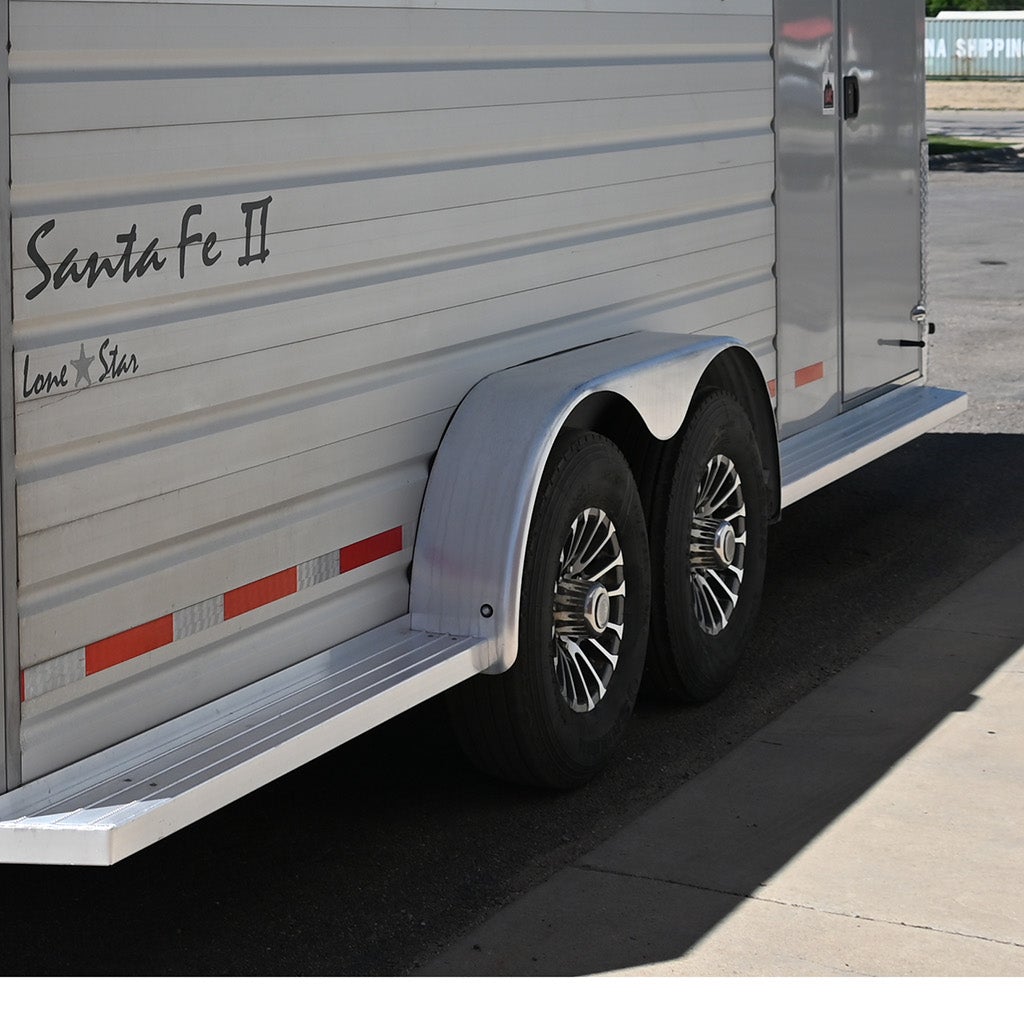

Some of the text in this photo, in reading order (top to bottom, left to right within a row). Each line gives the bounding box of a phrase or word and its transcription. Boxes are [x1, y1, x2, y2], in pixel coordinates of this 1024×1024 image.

[956, 38, 1024, 58] SHIPPIN
[25, 195, 273, 300] Santa Fe II
[23, 338, 139, 398] Lone Star
